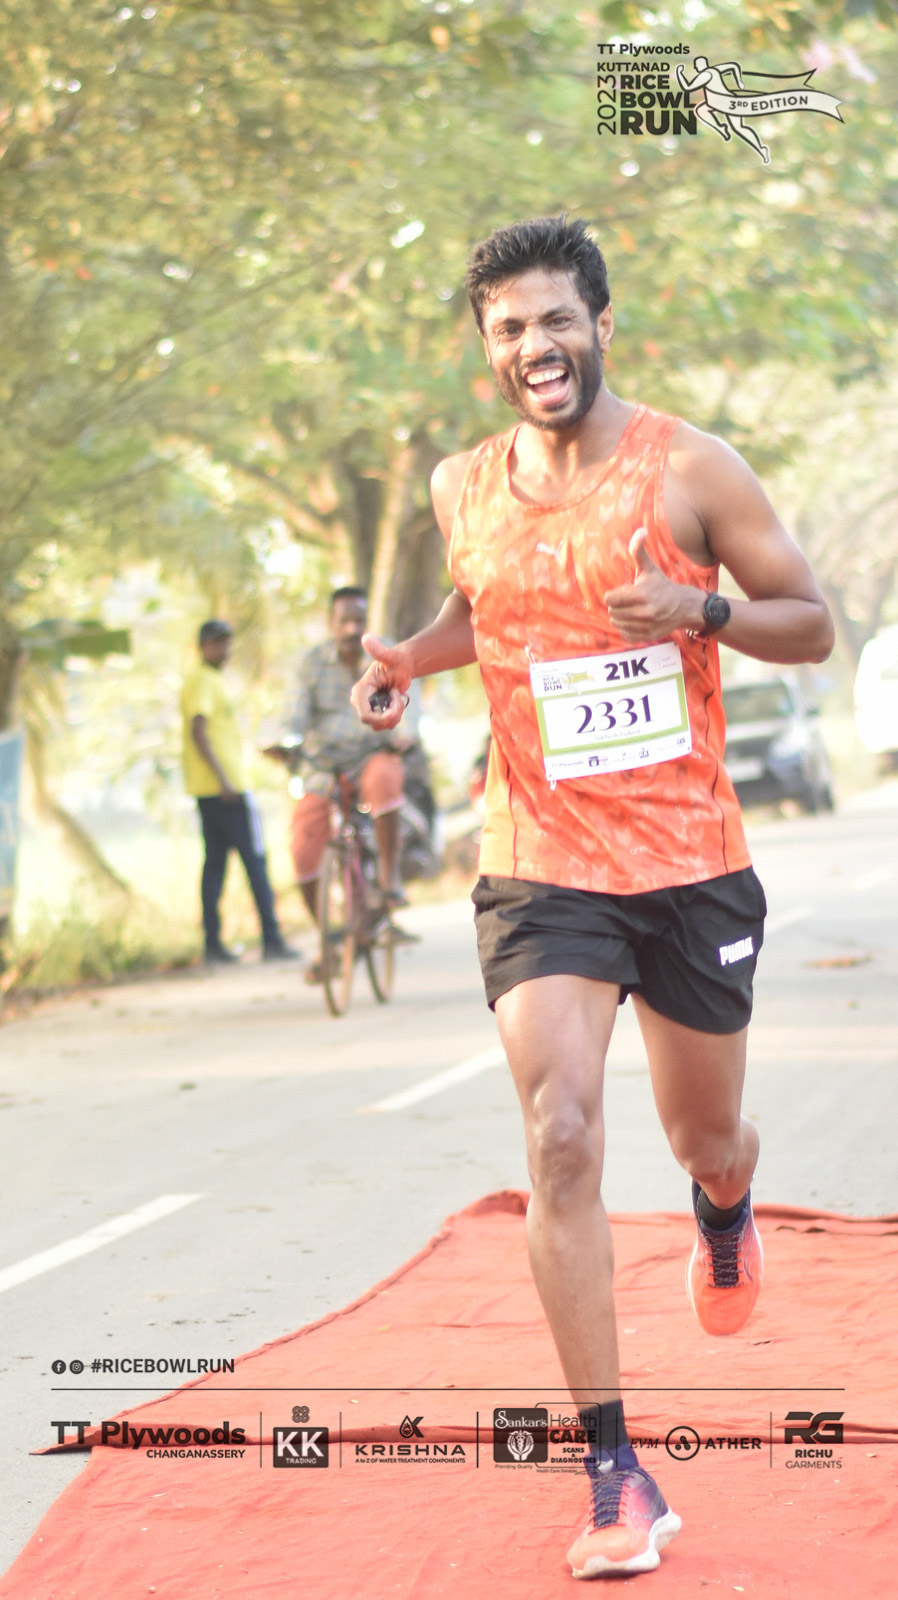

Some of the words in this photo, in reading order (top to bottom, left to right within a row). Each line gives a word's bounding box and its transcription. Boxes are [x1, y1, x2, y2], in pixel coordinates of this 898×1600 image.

[604, 656, 650, 681] 21K
[574, 694, 653, 734] 2331
[719, 936, 754, 966] PUMA
